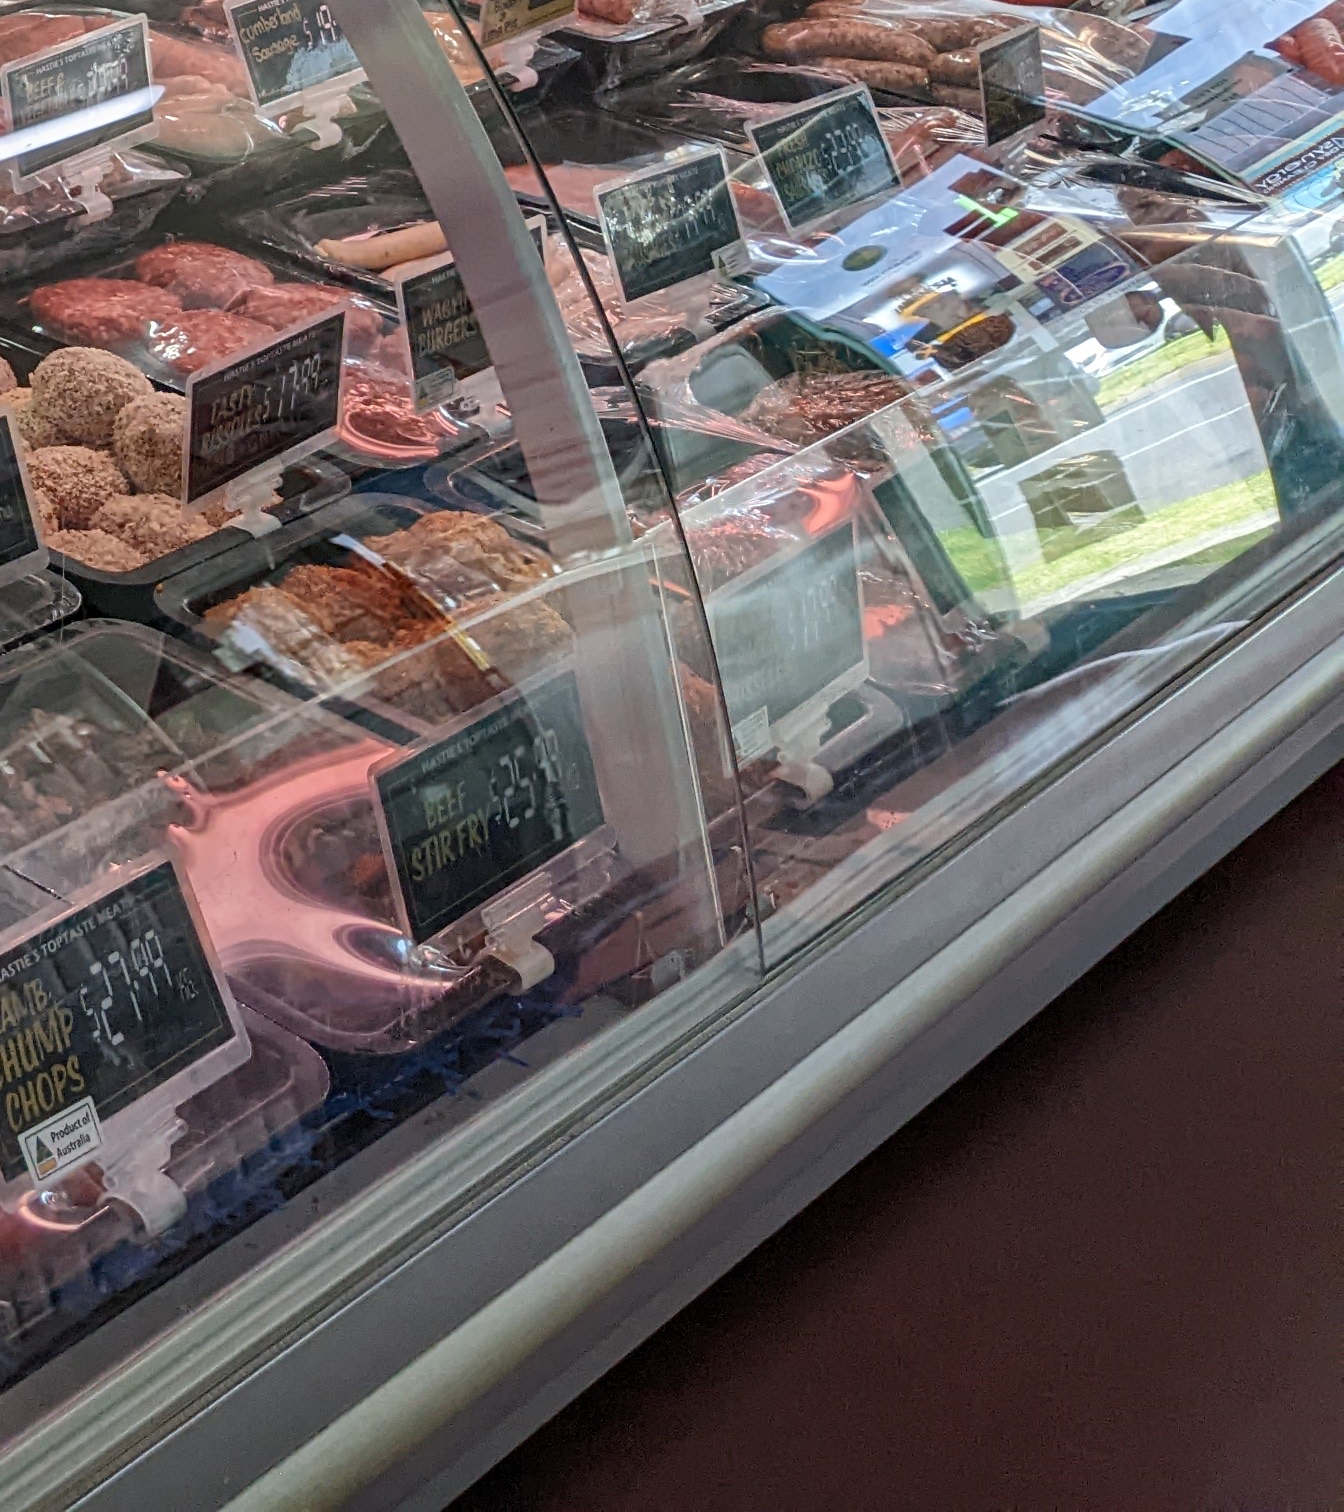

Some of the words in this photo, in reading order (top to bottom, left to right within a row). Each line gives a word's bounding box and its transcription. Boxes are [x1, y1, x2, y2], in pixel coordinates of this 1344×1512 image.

[239, 3, 302, 44] Cumberland
[412, 830, 455, 882] STIR
[456, 805, 491, 854] FRY
[6, 1055, 86, 1132] CHOPS
[50, 1122, 81, 1144] Product
[56, 1133, 91, 1159] Australia
